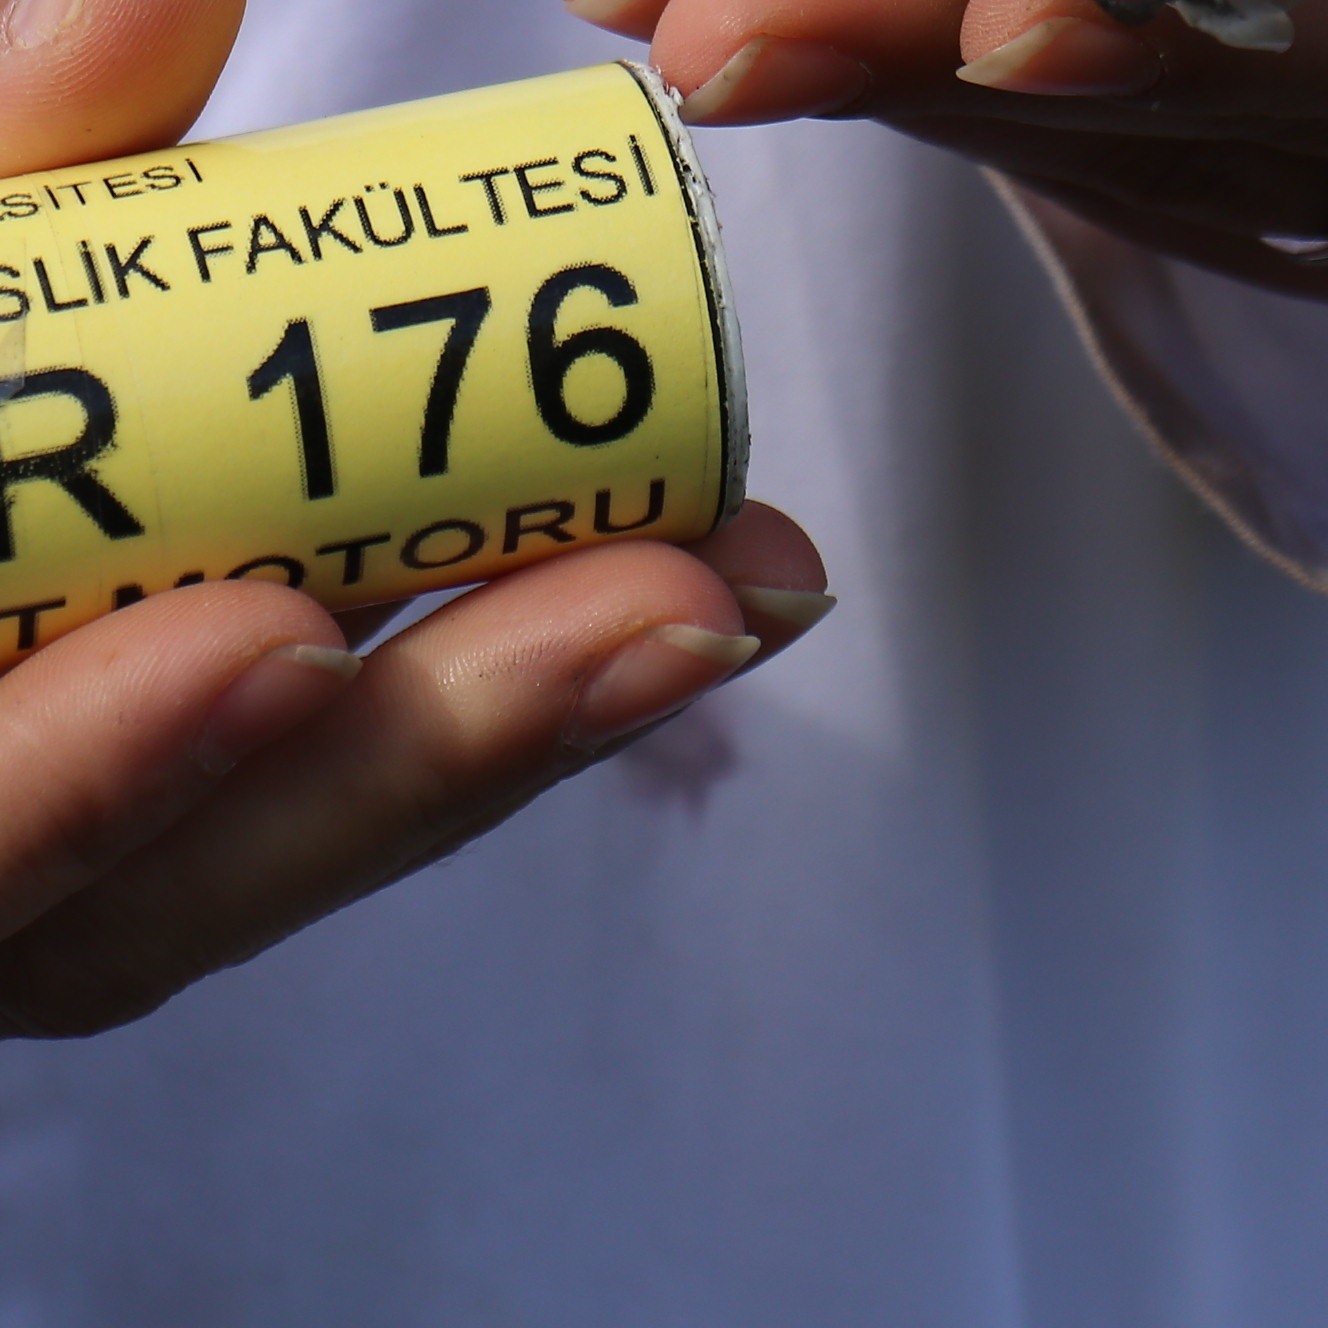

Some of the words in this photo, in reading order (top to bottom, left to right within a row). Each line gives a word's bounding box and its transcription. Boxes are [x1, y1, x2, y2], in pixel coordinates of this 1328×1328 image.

[186, 134, 660, 283] FAKÜLTESİ
[247, 260, 658, 501] 176
[111, 478, 668, 611] TORU
